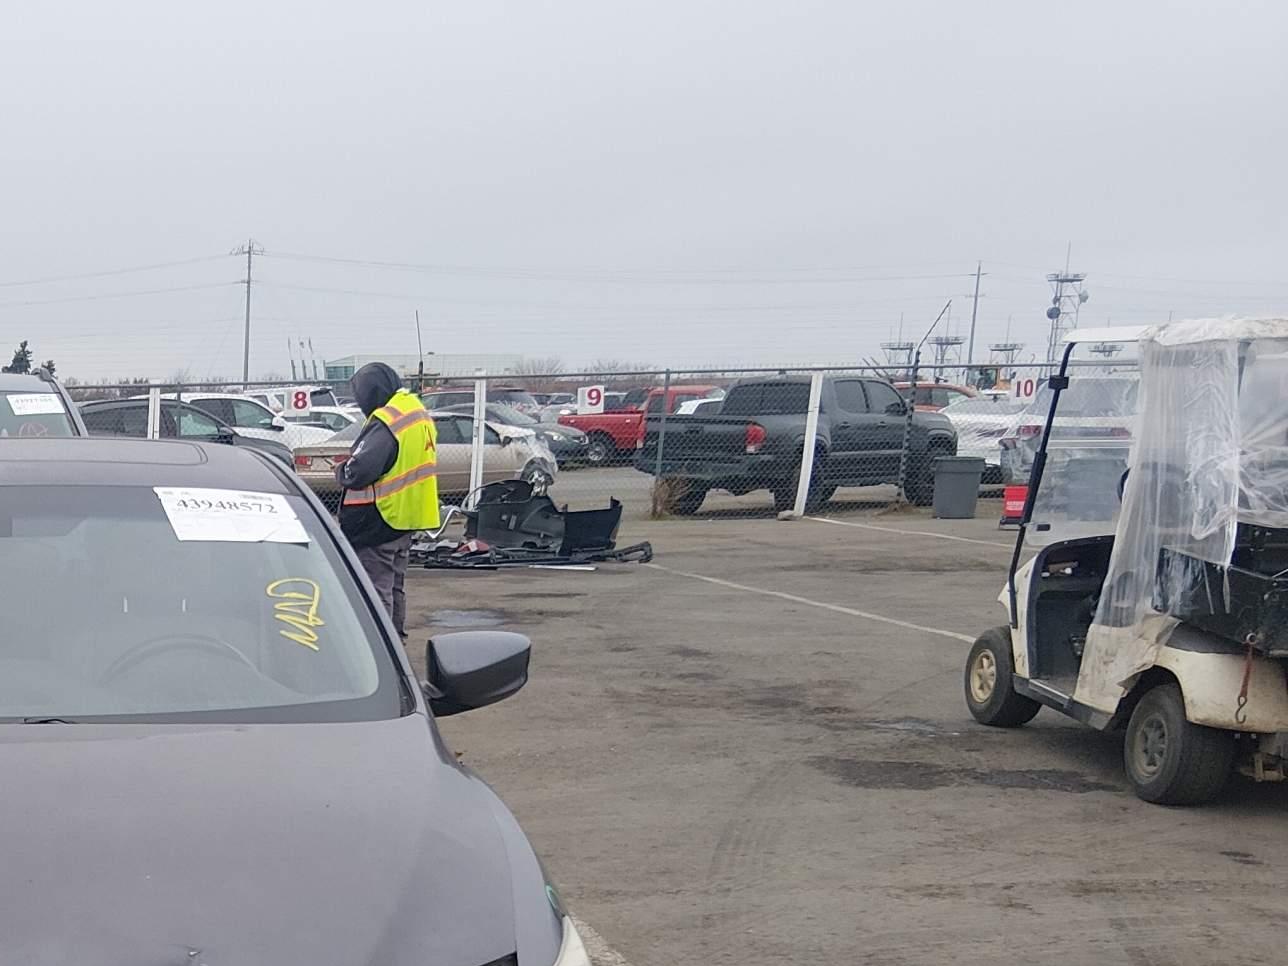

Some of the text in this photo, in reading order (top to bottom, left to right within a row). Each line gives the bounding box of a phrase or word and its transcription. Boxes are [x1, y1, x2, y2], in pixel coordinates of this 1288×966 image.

[587, 388, 602, 406] 9
[1015, 379, 1034, 398] 10
[294, 391, 307, 410] 8
[177, 498, 278, 514] 43948572
